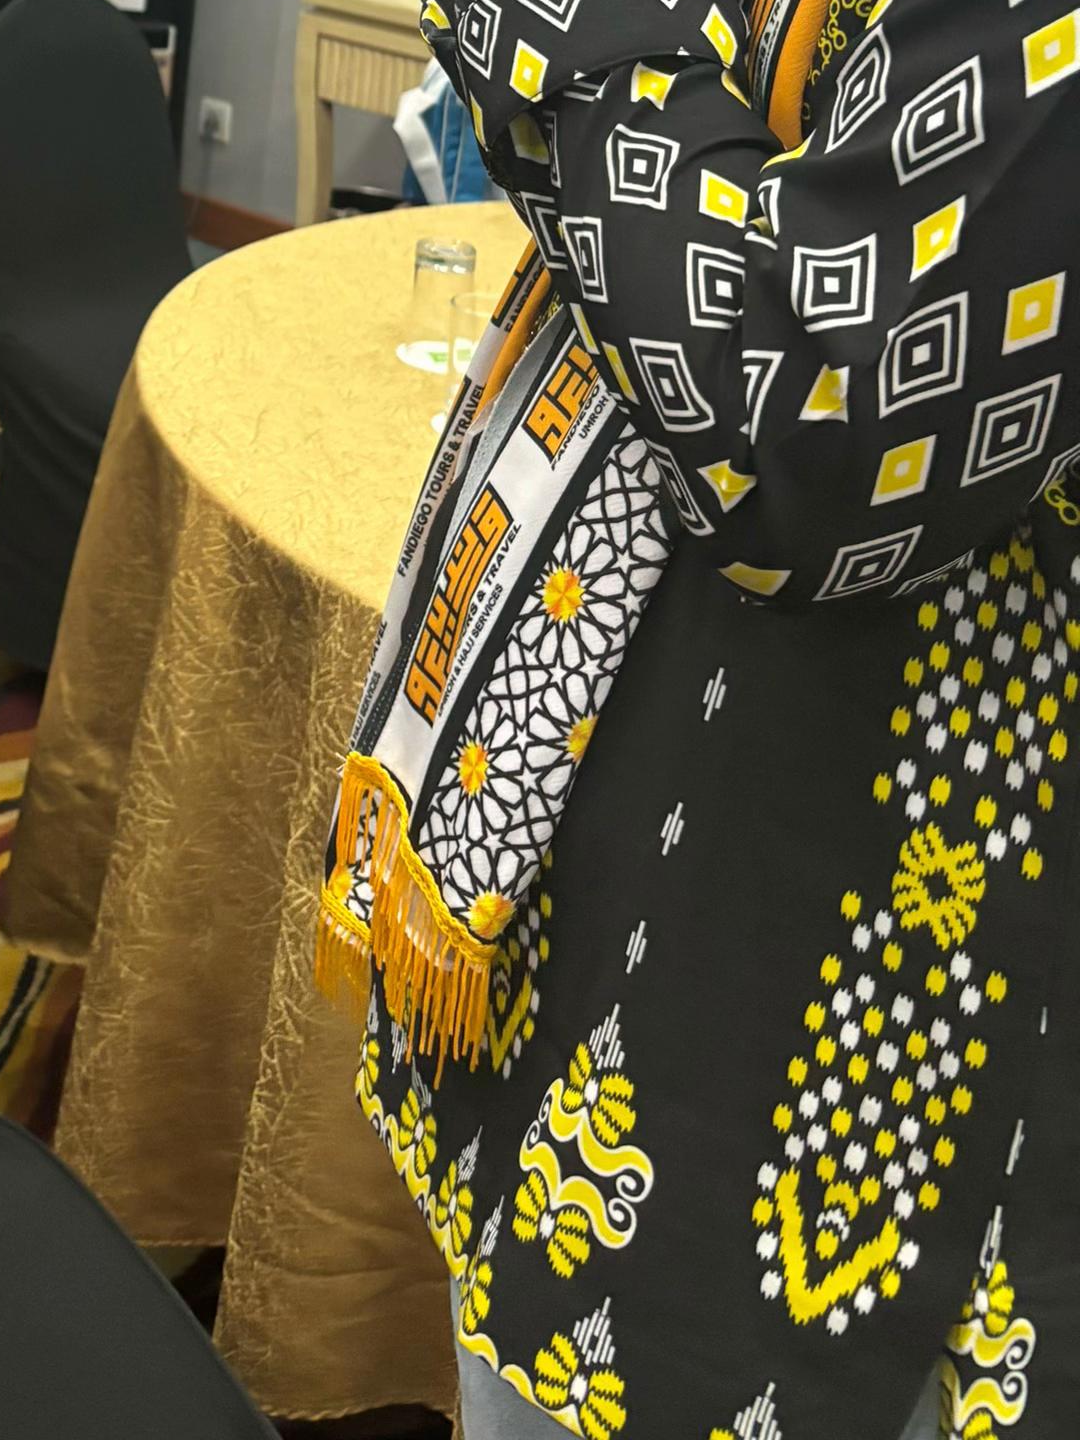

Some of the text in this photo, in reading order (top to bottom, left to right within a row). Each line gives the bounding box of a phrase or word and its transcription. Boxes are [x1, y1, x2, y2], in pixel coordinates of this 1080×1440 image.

[551, 384, 601, 471] FANDIEGO
[579, 394, 610, 440] UMROH
[397, 383, 487, 577] FANDIEGO TOURS & TRAVEL
[476, 589, 488, 603] &
[483, 523, 522, 587] TRAVEL
[459, 638, 475, 666] HAJJ
[472, 582, 505, 642] SERVICES
[360, 671, 381, 717] SERVICES
